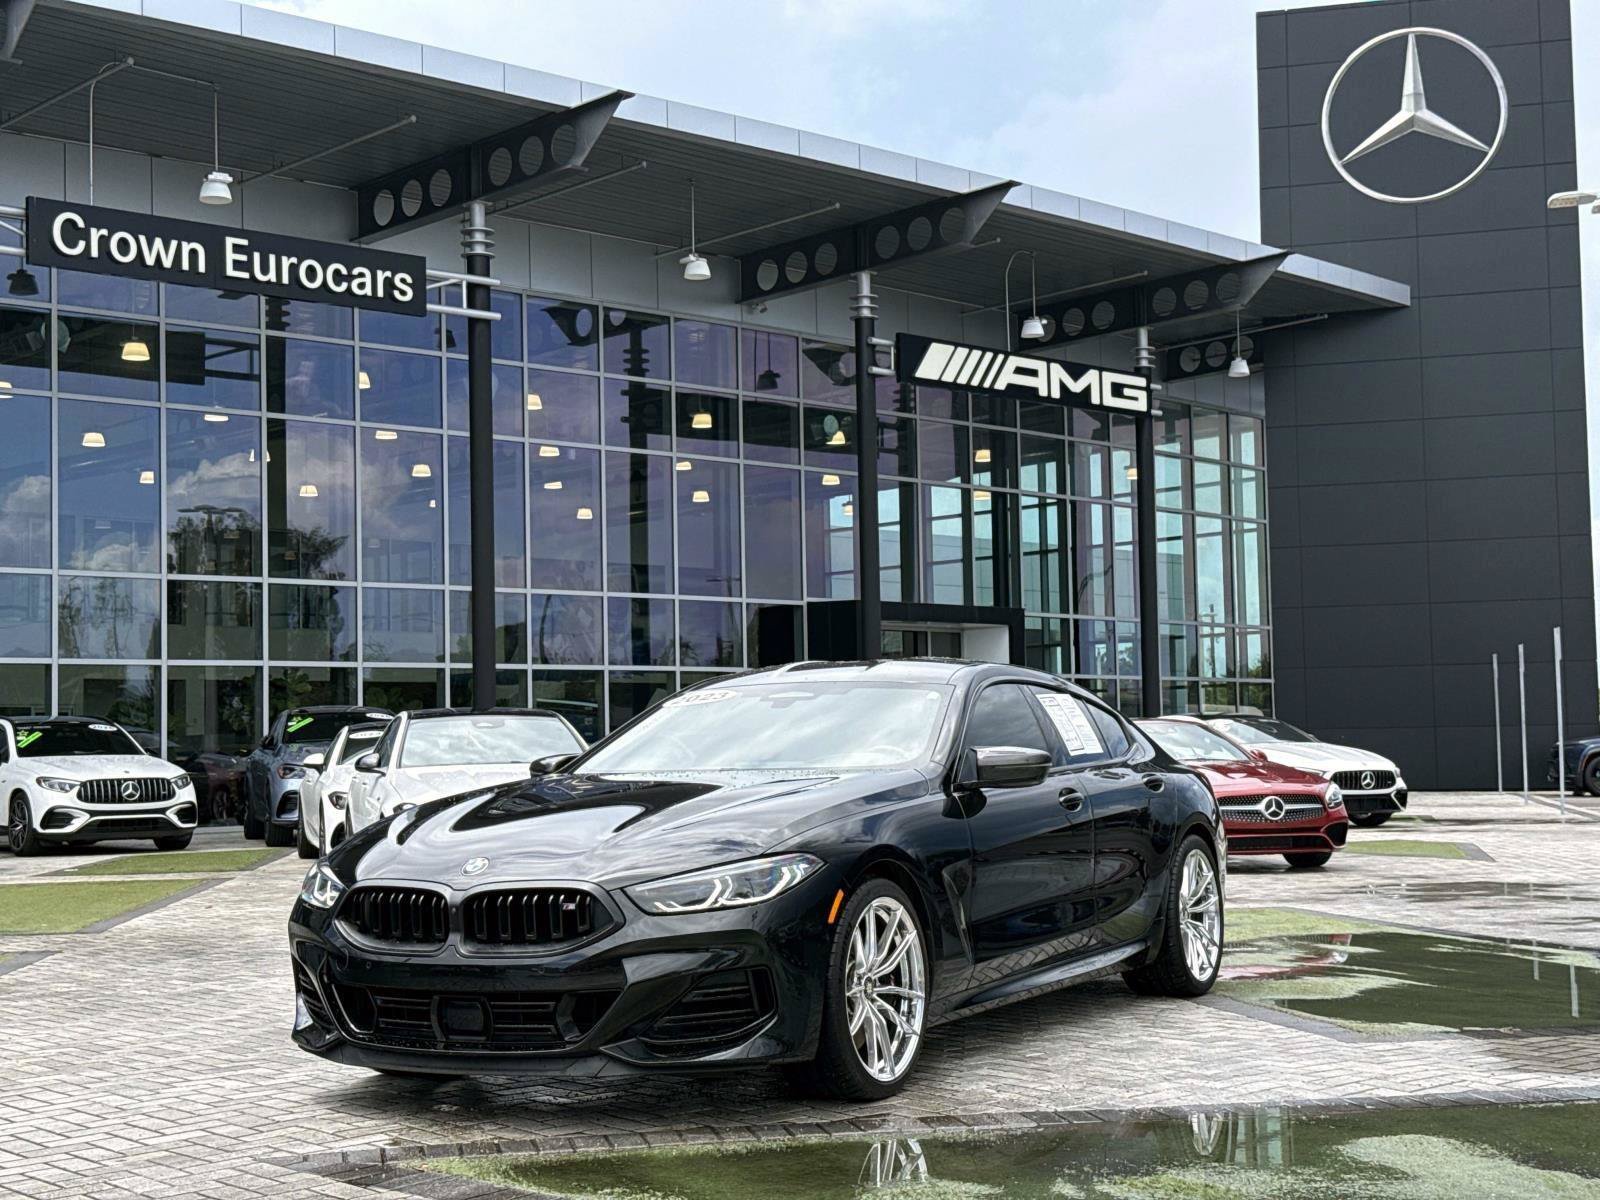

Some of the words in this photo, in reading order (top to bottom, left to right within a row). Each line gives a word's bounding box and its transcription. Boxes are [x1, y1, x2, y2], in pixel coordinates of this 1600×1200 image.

[52, 211, 206, 274] Crown
[225, 235, 414, 302] Eurocars
[993, 355, 1148, 412] AMG
